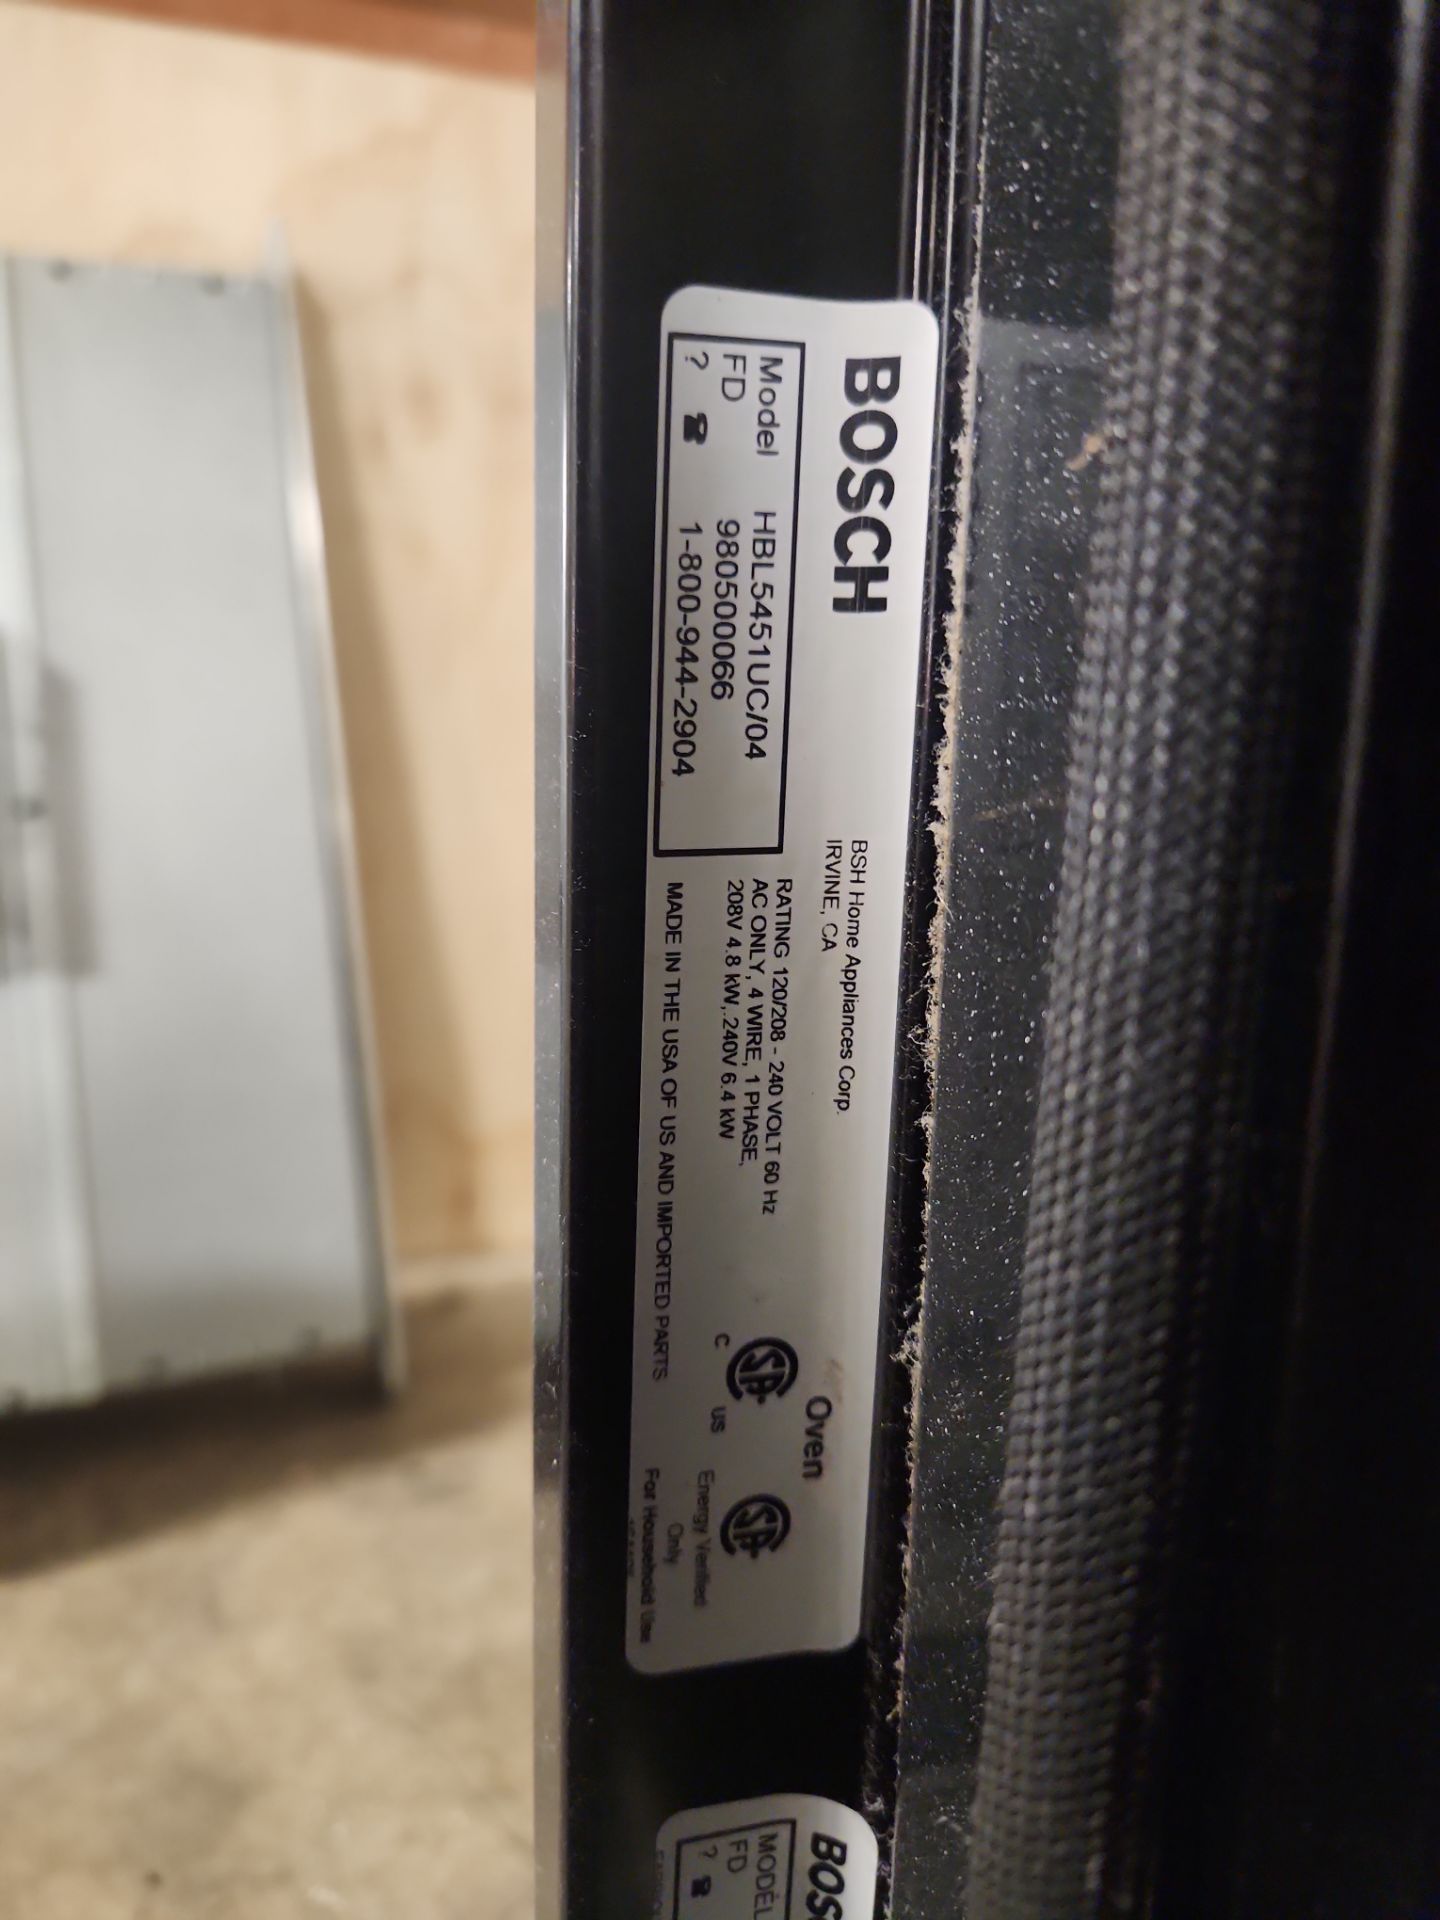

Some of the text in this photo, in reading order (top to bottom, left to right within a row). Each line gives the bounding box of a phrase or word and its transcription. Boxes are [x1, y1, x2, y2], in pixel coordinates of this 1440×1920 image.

[832, 355, 901, 612] BOSCH
[711, 353, 745, 700] FD 980500066
[744, 356, 782, 759] Model HBL5451UC/04
[672, 351, 708, 776] ? 1-800-944-2904
[726, 880, 742, 930] 208V
[751, 879, 767, 909] AC
[773, 879, 791, 958] RATING
[820, 840, 841, 952] IRVINE, CA
[725, 937, 739, 967] 4.8
[746, 915, 765, 980] ONLY,
[834, 840, 867, 1115] BSH Home Appliances Corp.
[748, 988, 761, 998] 4
[770, 968, 787, 1042] 120/208
[743, 1004, 761, 1066] WIRE,
[720, 1072, 735, 1101] 6.4
[767, 1062, 784, 1095] 240
[652, 882, 682, 1381] MADE IN THE USA OF US AND IMPORTED PARTS
[719, 1109, 734, 1139] kW
[739, 1092, 758, 1166] PHASE,
[765, 1101, 781, 1154] VOLT
[762, 1191, 777, 1215] Hz
[764, 1162, 779, 1184] 60
[711, 1407, 726, 1433] US
[802, 1396, 832, 1480] Oven
[693, 1470, 714, 1533] Energy
[639, 1468, 658, 1643] For Household Use
[664, 1524, 683, 1565] Only
[726, 1840, 747, 1873] FD
[805, 1832, 846, 1920] BOS
